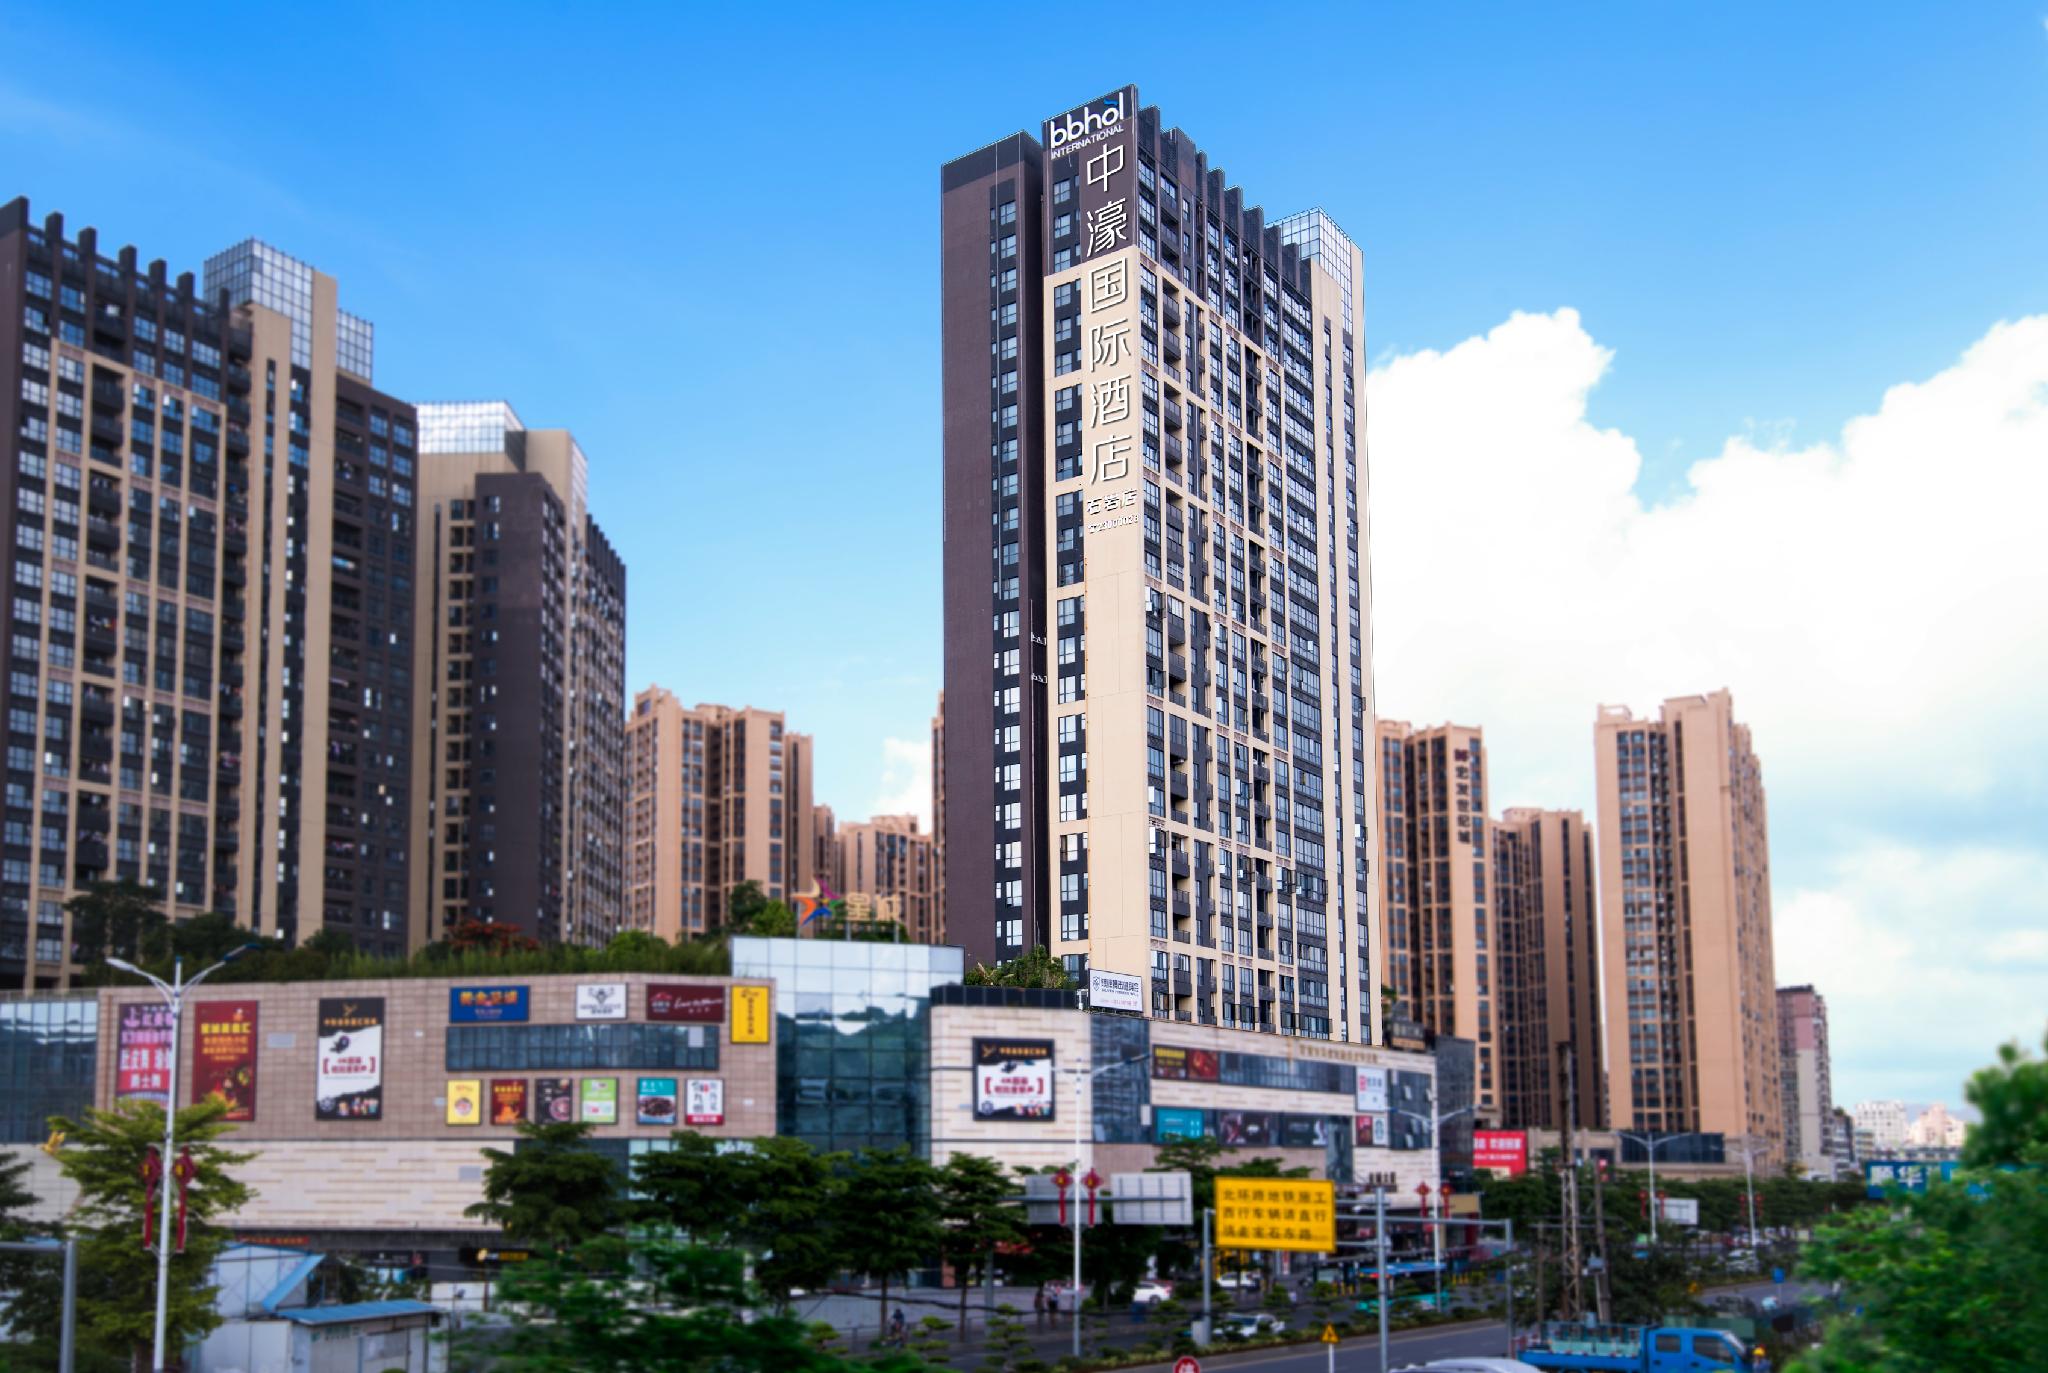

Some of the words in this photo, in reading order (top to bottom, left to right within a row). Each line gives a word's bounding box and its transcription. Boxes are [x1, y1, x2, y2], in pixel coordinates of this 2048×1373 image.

[1051, 124, 1124, 160] INTERNATIONAL
[1086, 143, 1132, 486] 中濠国际酒店
